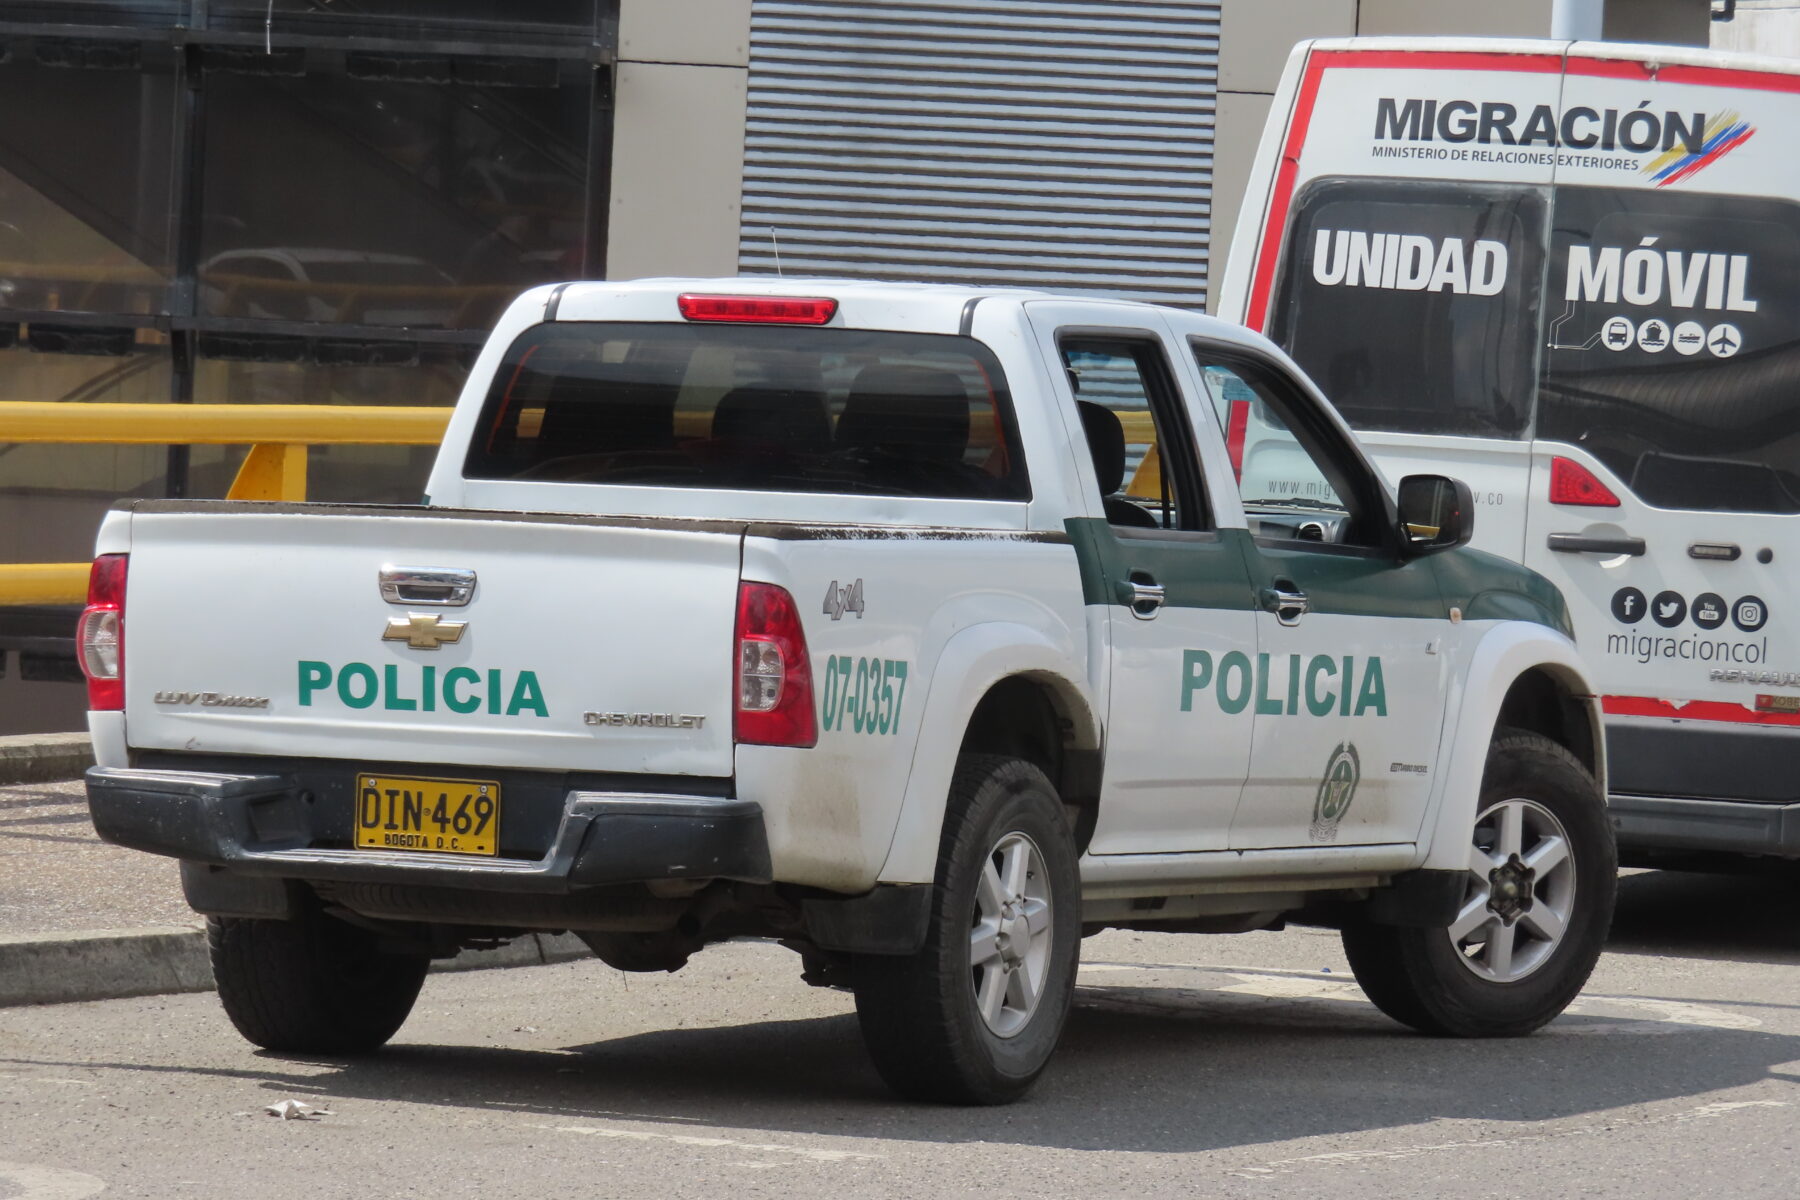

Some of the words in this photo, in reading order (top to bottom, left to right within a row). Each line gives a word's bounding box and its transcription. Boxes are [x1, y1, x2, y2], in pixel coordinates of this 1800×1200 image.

[1374, 97, 1706, 156] MIGRACIÓN
[1371, 146, 1447, 160] MINISTERIO
[1451, 150, 1468, 161] DE
[1471, 151, 1554, 165] RELACIONES
[1556, 155, 1639, 171] EXTERIORES
[1313, 229, 1508, 296] UNIDAD
[1565, 236, 1757, 313] MÓVIL
[823, 578, 864, 621] 4x4
[1607, 628, 1767, 664] migracioncol
[298, 660, 549, 718] POLICIA
[823, 654, 908, 735] 07-0357
[1180, 649, 1387, 717] POLICIA
[584, 710, 706, 729] CHEVROLET
[384, 833, 429, 848] BOGOTA
